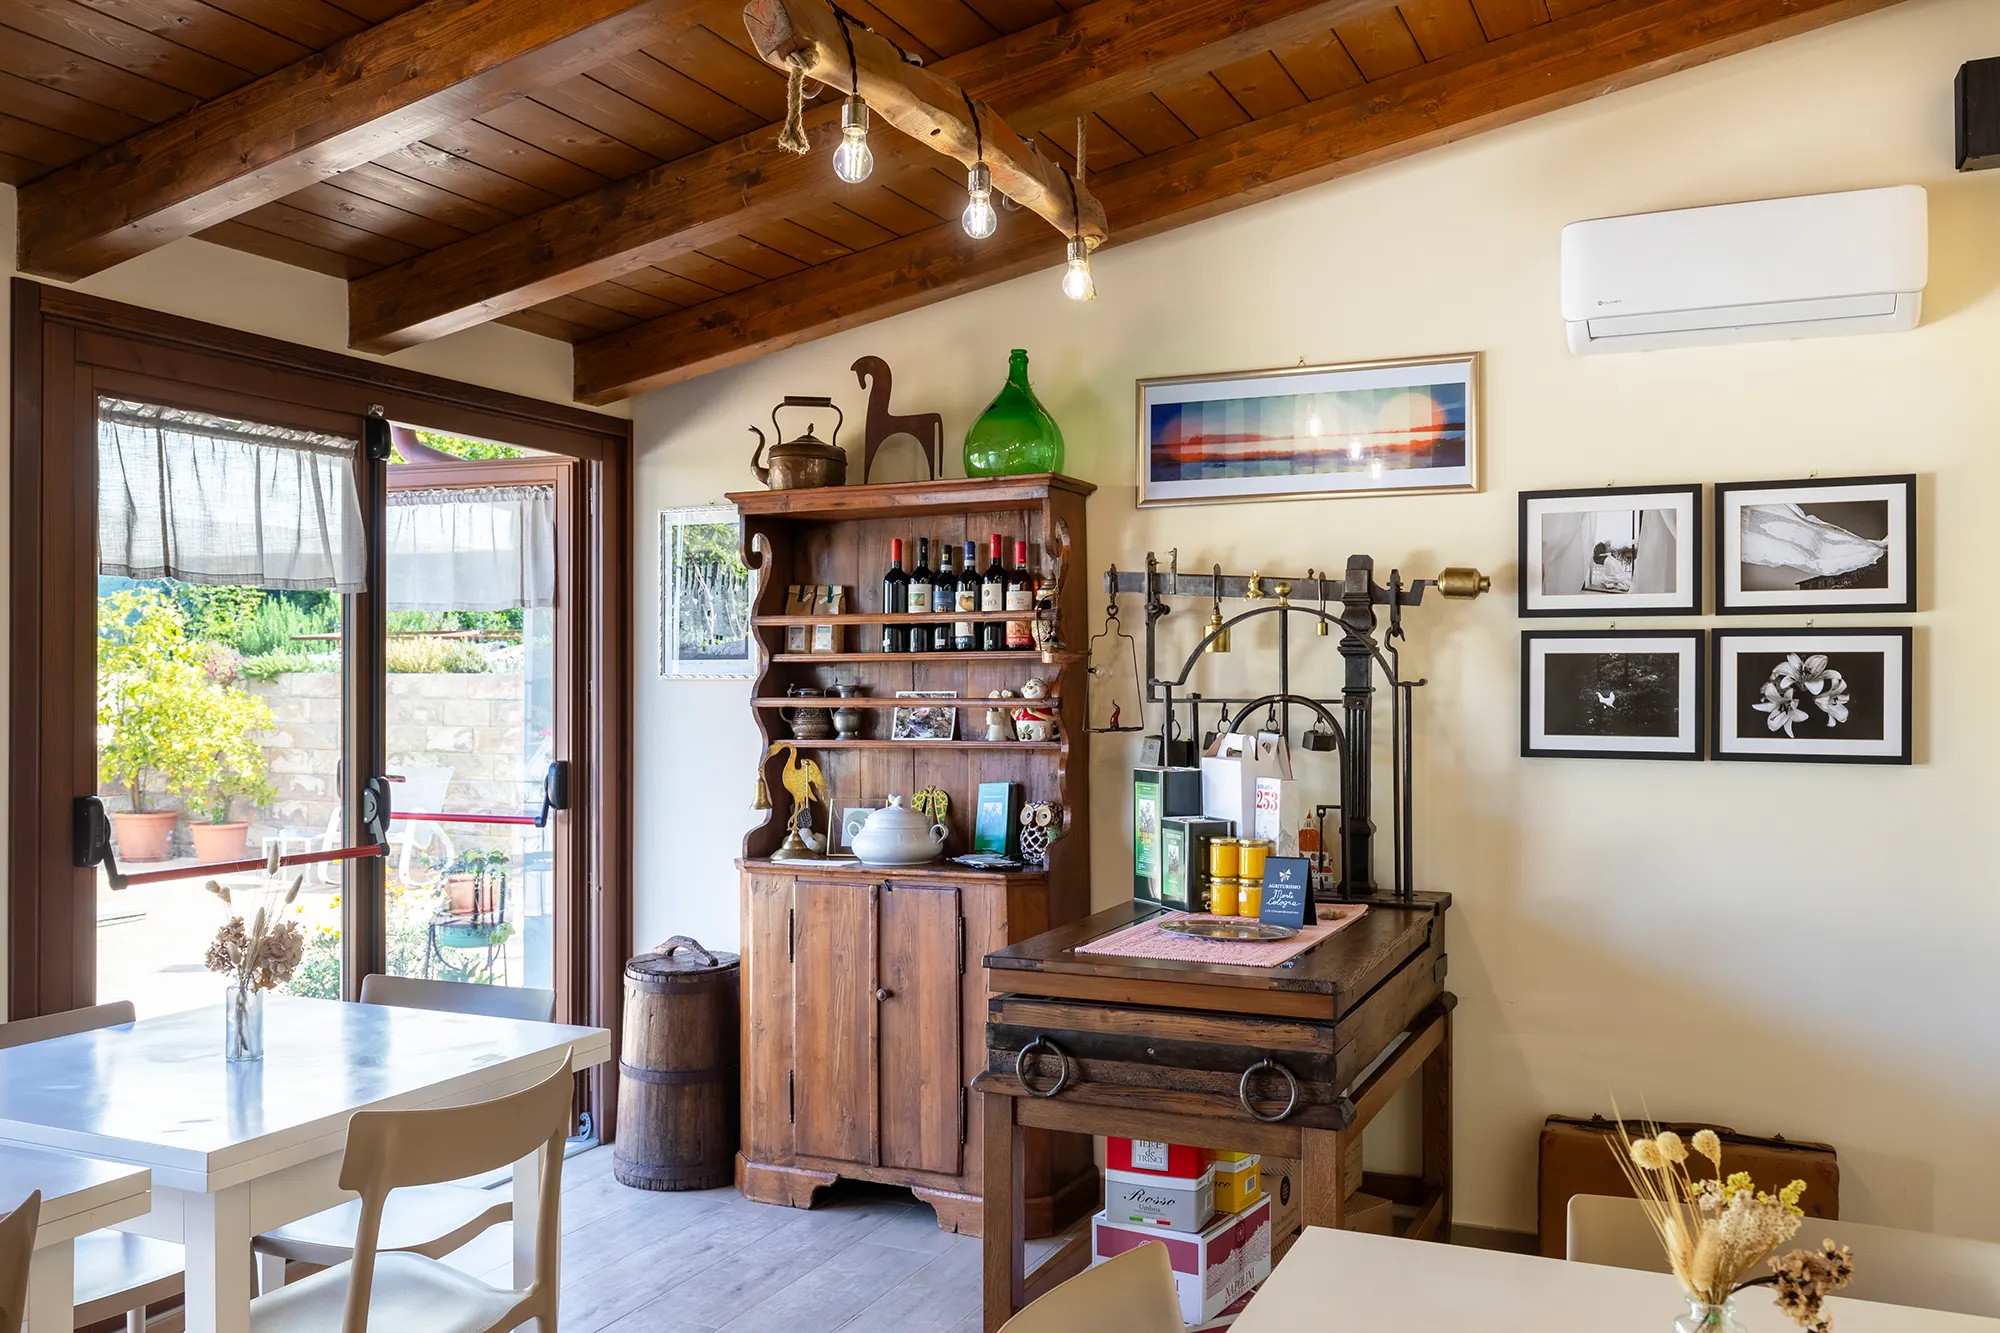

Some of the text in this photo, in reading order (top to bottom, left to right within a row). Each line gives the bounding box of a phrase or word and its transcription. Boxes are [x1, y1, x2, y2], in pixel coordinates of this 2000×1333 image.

[1256, 790, 1278, 811] 253
[1136, 1154, 1163, 1164] TRINCI
[1123, 1188, 1176, 1206] Rosso
